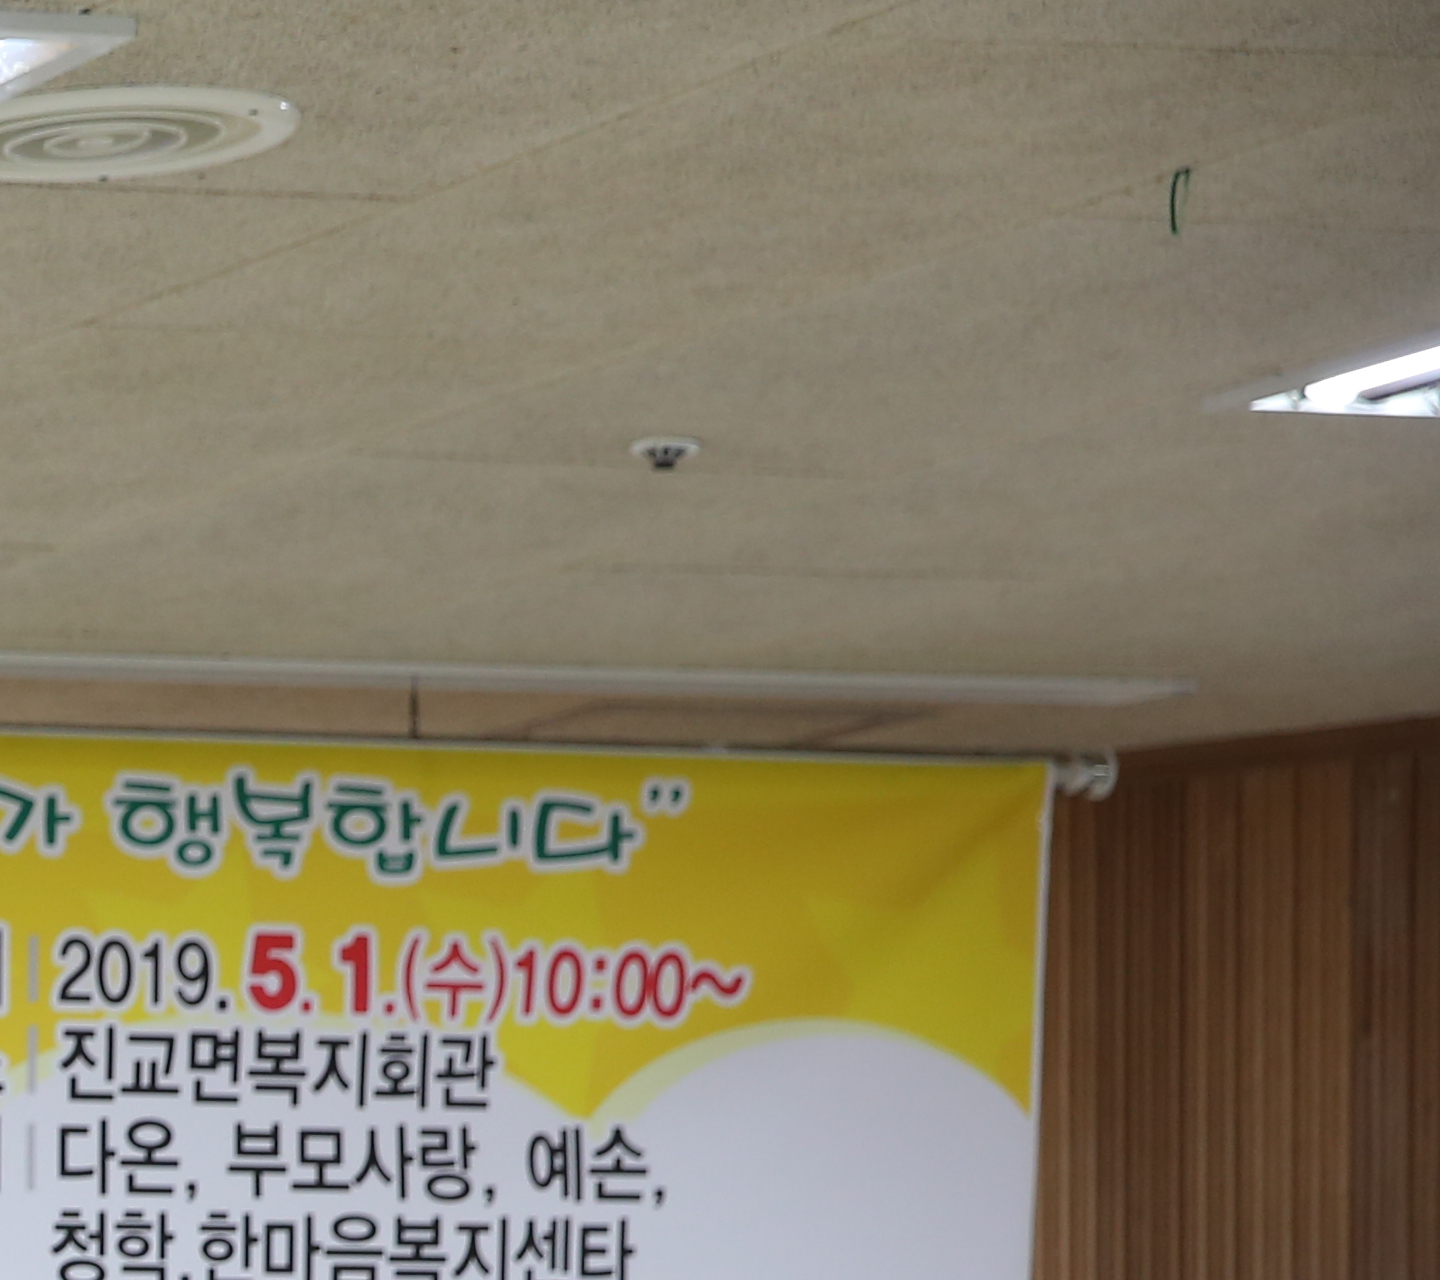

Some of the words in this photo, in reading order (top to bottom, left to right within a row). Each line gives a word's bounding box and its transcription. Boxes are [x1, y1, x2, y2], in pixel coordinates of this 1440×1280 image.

[59, 1025, 498, 1110] 진교면복지회관
[57, 1117, 200, 1204] 다온,
[229, 1121, 497, 1206] 부모사랑,
[526, 1125, 668, 1206] 예손,
